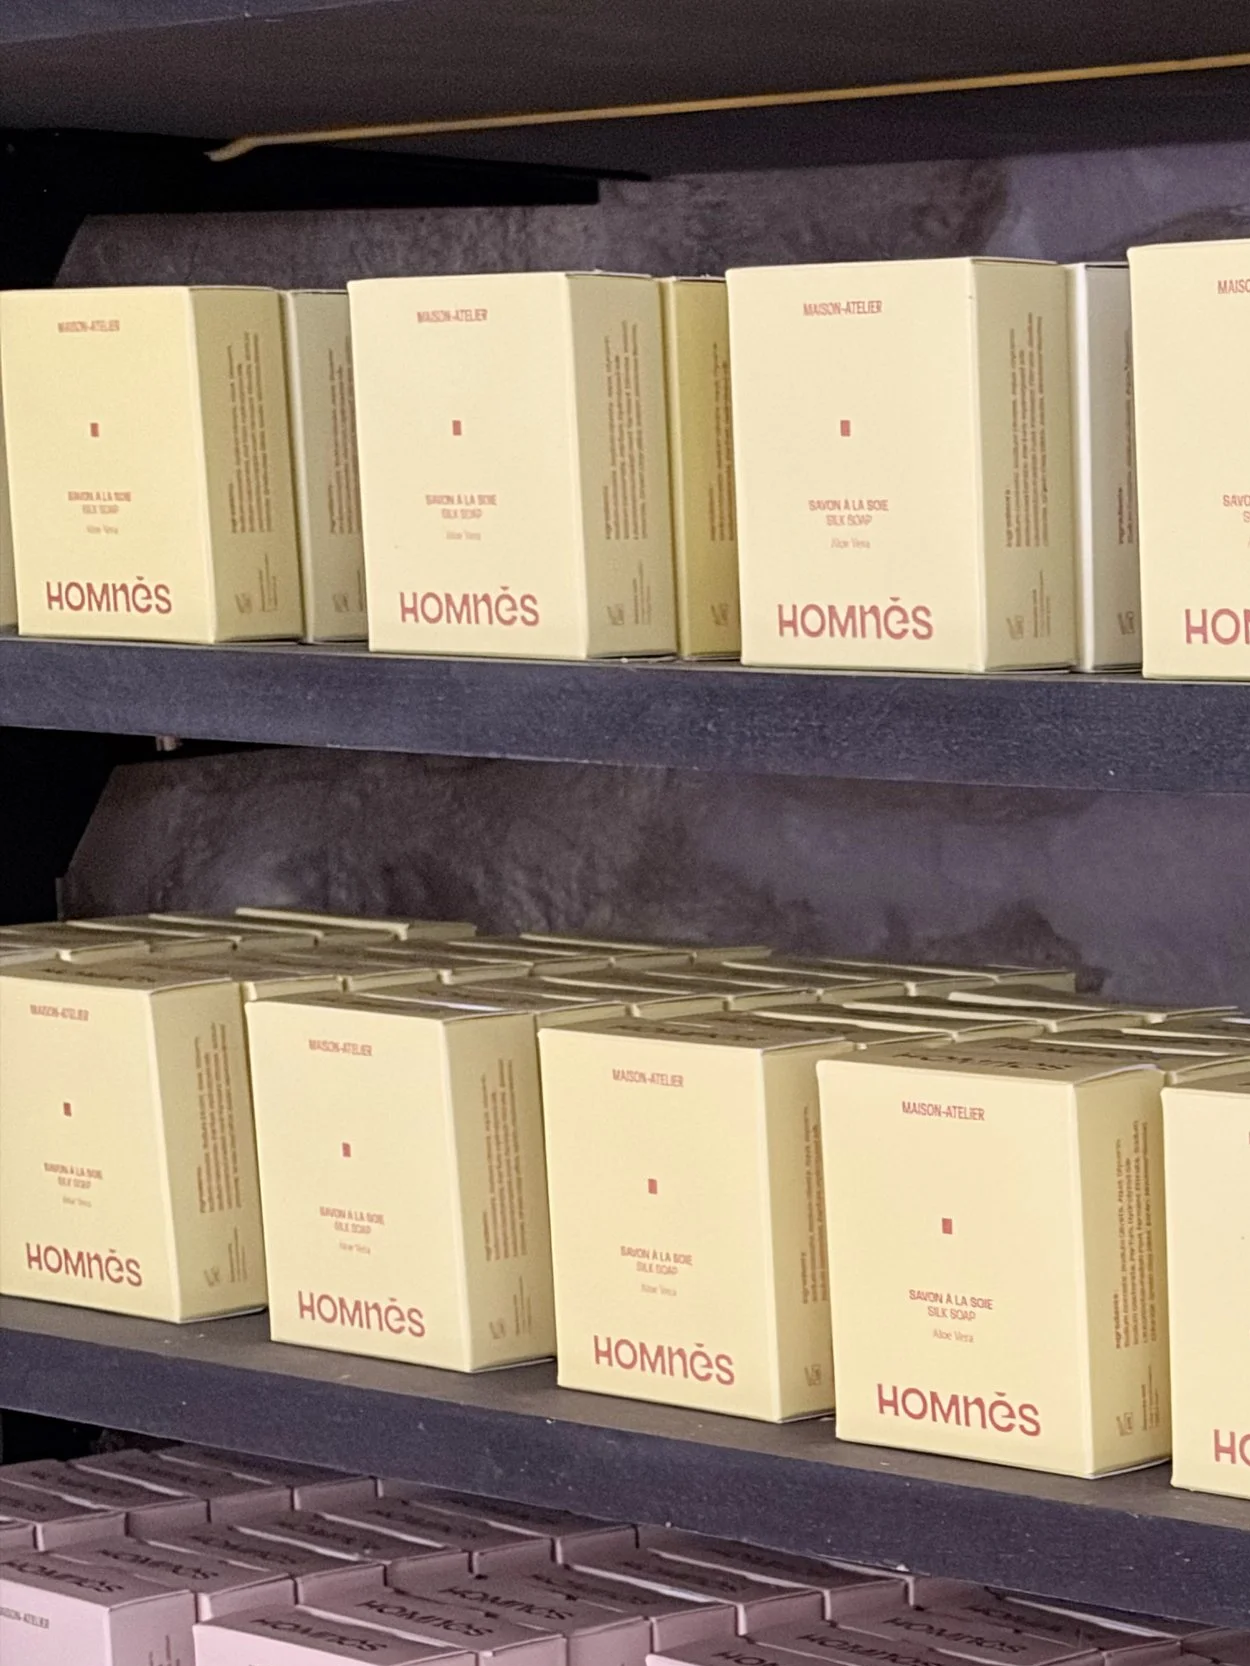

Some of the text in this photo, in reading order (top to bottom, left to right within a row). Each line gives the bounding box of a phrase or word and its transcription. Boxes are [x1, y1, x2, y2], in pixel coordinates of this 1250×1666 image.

[901, 1100, 984, 1120] MAISON-ATELIER
[908, 1289, 943, 1303] SAVON
[954, 1295, 968, 1306] LA
[969, 1296, 992, 1310] SOIE
[927, 1305, 976, 1321] SILK SOAP
